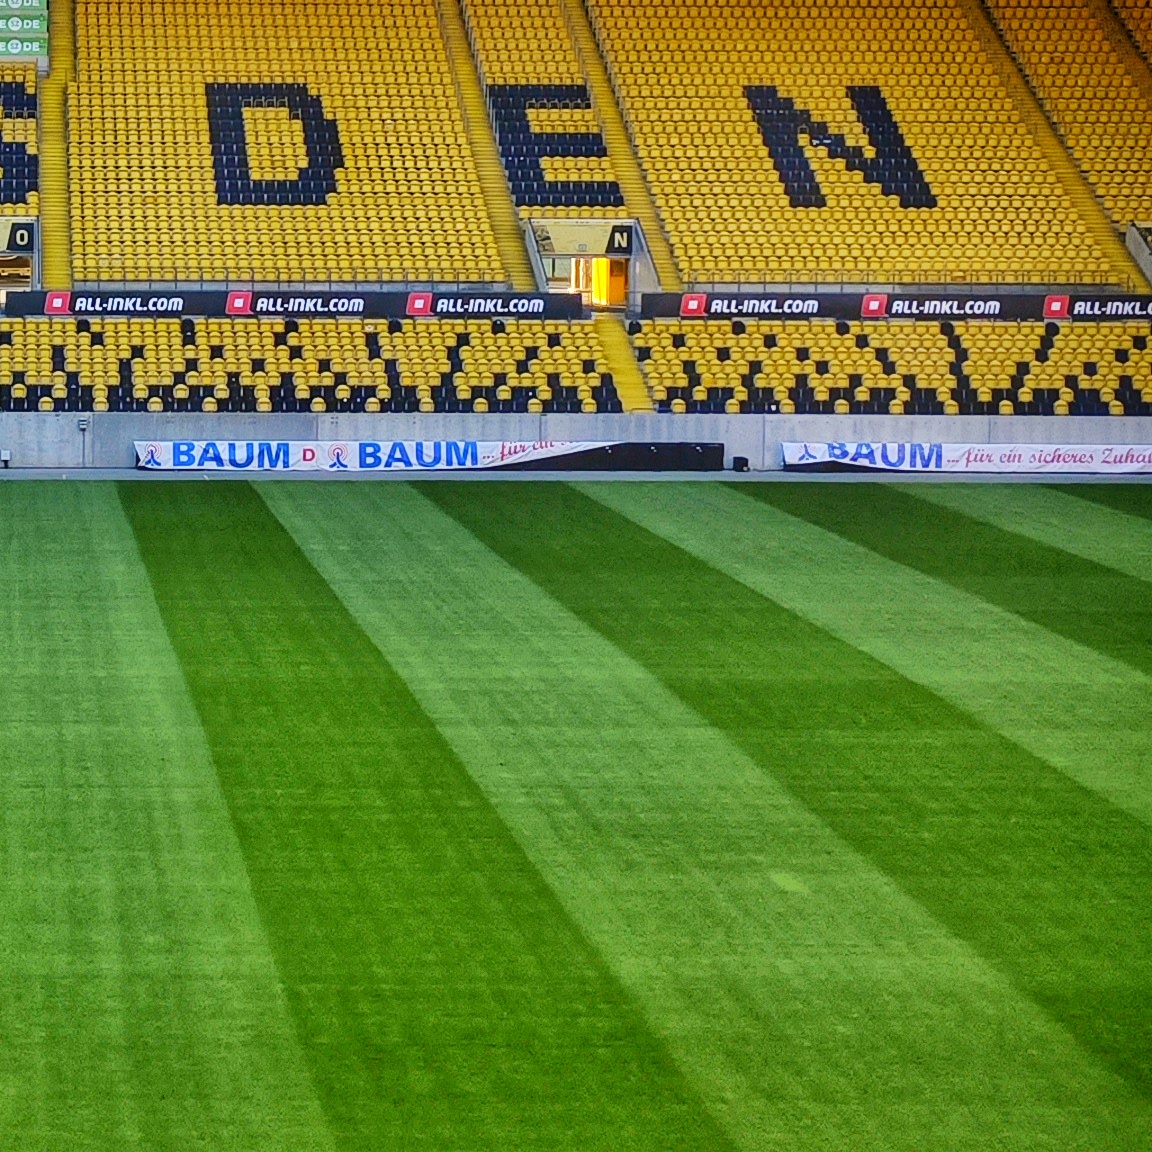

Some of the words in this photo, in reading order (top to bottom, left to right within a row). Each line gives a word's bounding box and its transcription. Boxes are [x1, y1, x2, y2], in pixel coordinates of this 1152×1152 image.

[23, 19, 40, 28] DE
[23, 42, 40, 51] DE
[614, 232, 627, 247] N
[74, 297, 183, 311] ALL-INKL.COM
[256, 298, 364, 312] ALL-INKL.COM
[436, 298, 544, 313] ALL-INKL.COM
[710, 299, 819, 313] ALL-INKL.COM
[891, 300, 1001, 315] ALL-INKL.COM
[172, 441, 290, 468] BAUM
[302, 448, 315, 462] D
[358, 441, 478, 469] BAUM
[500, 441, 527, 461] für
[827, 443, 942, 468] BAUM
[965, 448, 994, 468] für
[999, 449, 1023, 464] ein
[1029, 448, 1094, 464] sicheres
